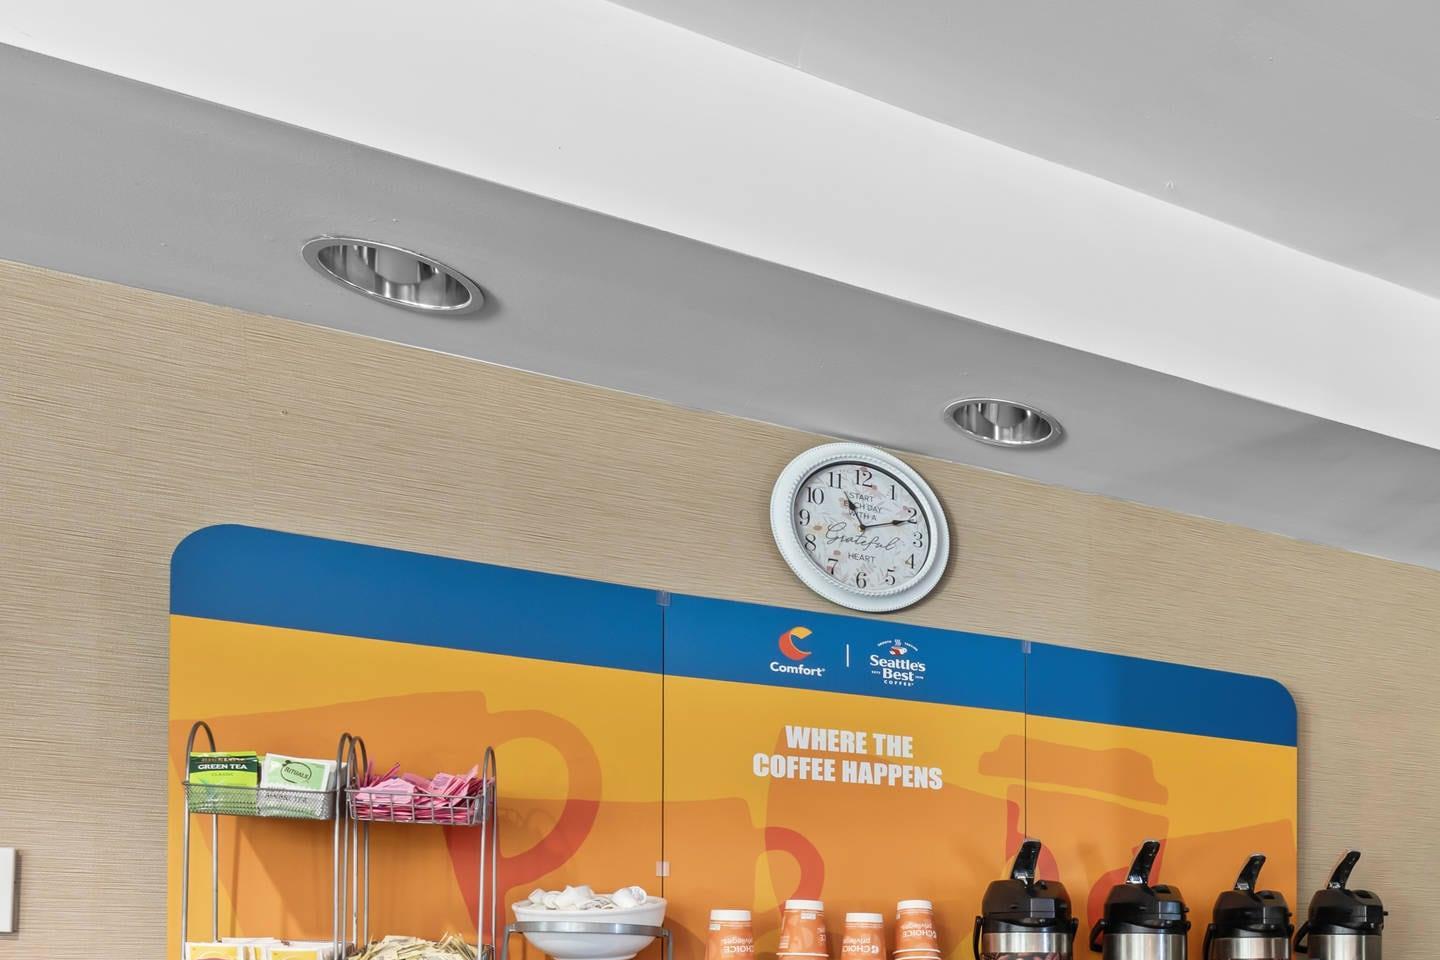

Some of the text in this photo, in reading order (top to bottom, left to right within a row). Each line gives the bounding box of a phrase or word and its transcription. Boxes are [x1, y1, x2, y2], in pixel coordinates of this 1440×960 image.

[828, 471, 842, 490] 11
[856, 469, 873, 488] 12
[806, 486, 824, 504] 10
[849, 492, 873, 502] START
[890, 484, 896, 500] 1
[843, 500, 866, 510] ECH
[799, 508, 810, 526] 9
[804, 534, 817, 552] 8
[826, 522, 898, 551] Grateful
[912, 532, 923, 548] 3
[828, 558, 838, 575] 7
[848, 553, 876, 563] HEART
[904, 554, 915, 569] 4
[856, 572, 867, 589] 6
[885, 568, 896, 586] 5
[770, 662, 824, 677] Comfort
[870, 654, 926, 672] Seattle's
[882, 668, 914, 682] Best
[785, 725, 914, 758] WHERE THE
[284, 766, 309, 780] RITUALS
[753, 753, 944, 790] COFFEE HAPPENS
